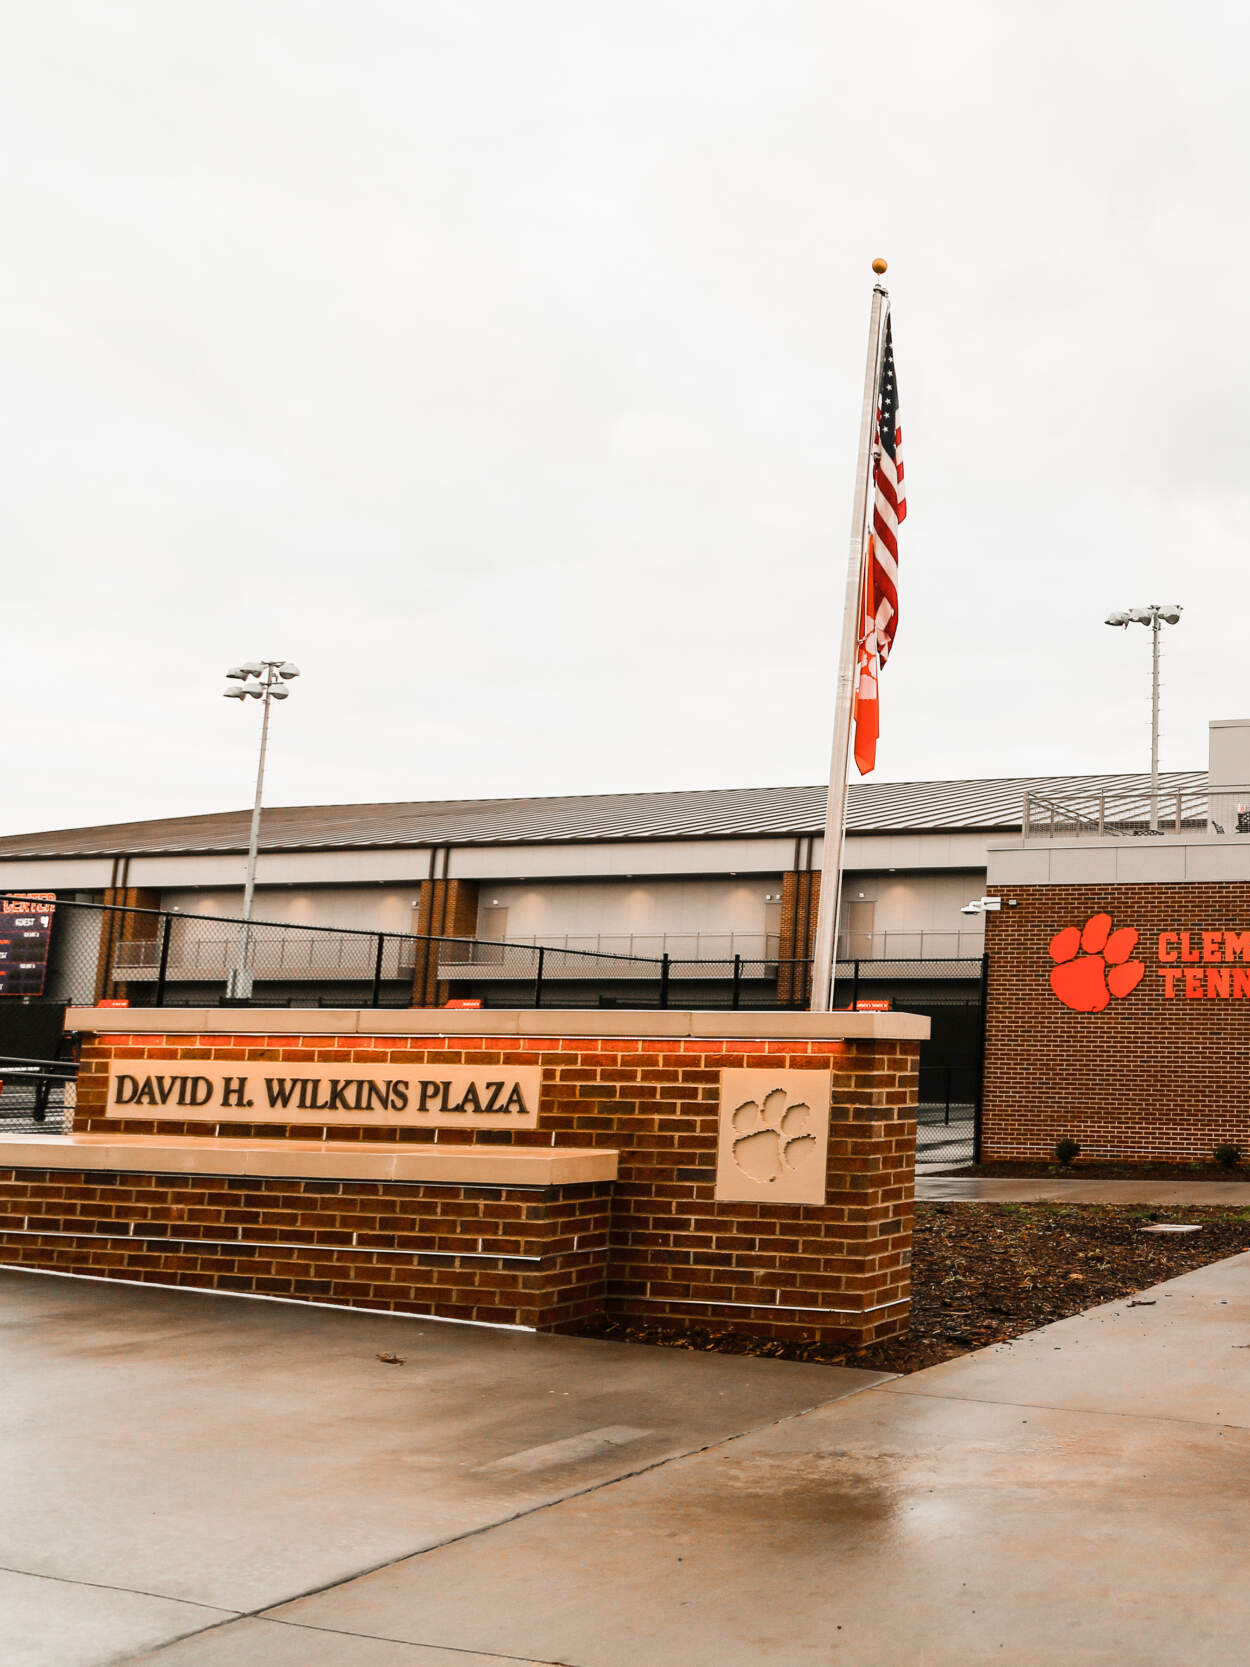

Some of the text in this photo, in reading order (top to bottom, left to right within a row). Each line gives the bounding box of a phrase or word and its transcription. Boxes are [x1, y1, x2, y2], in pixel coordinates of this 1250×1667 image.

[114, 1074, 530, 1114] DAVID H. WILKINS PLAZA
